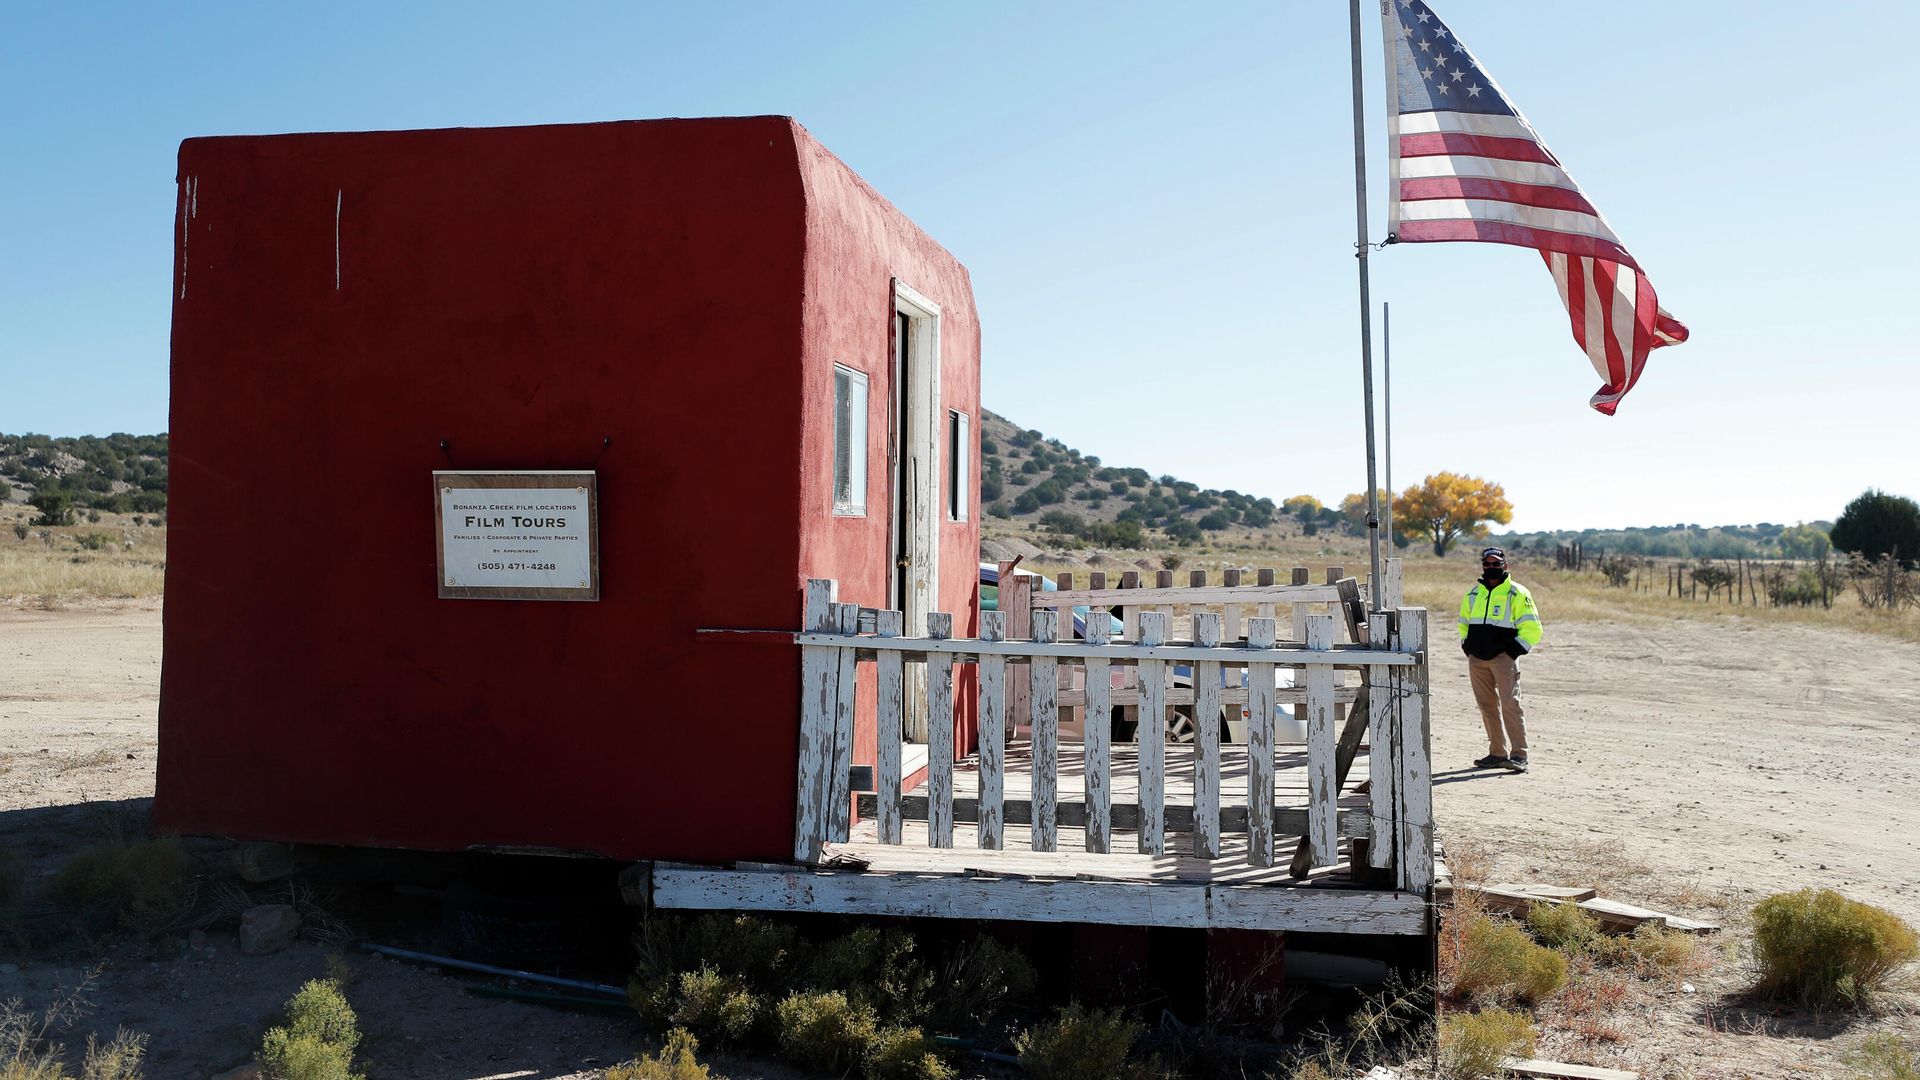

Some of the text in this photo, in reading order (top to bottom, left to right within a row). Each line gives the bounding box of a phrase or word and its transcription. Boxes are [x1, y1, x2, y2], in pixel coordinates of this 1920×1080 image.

[465, 516, 566, 528] FILM TOURS
[478, 563, 556, 571] (505) 471-4248
